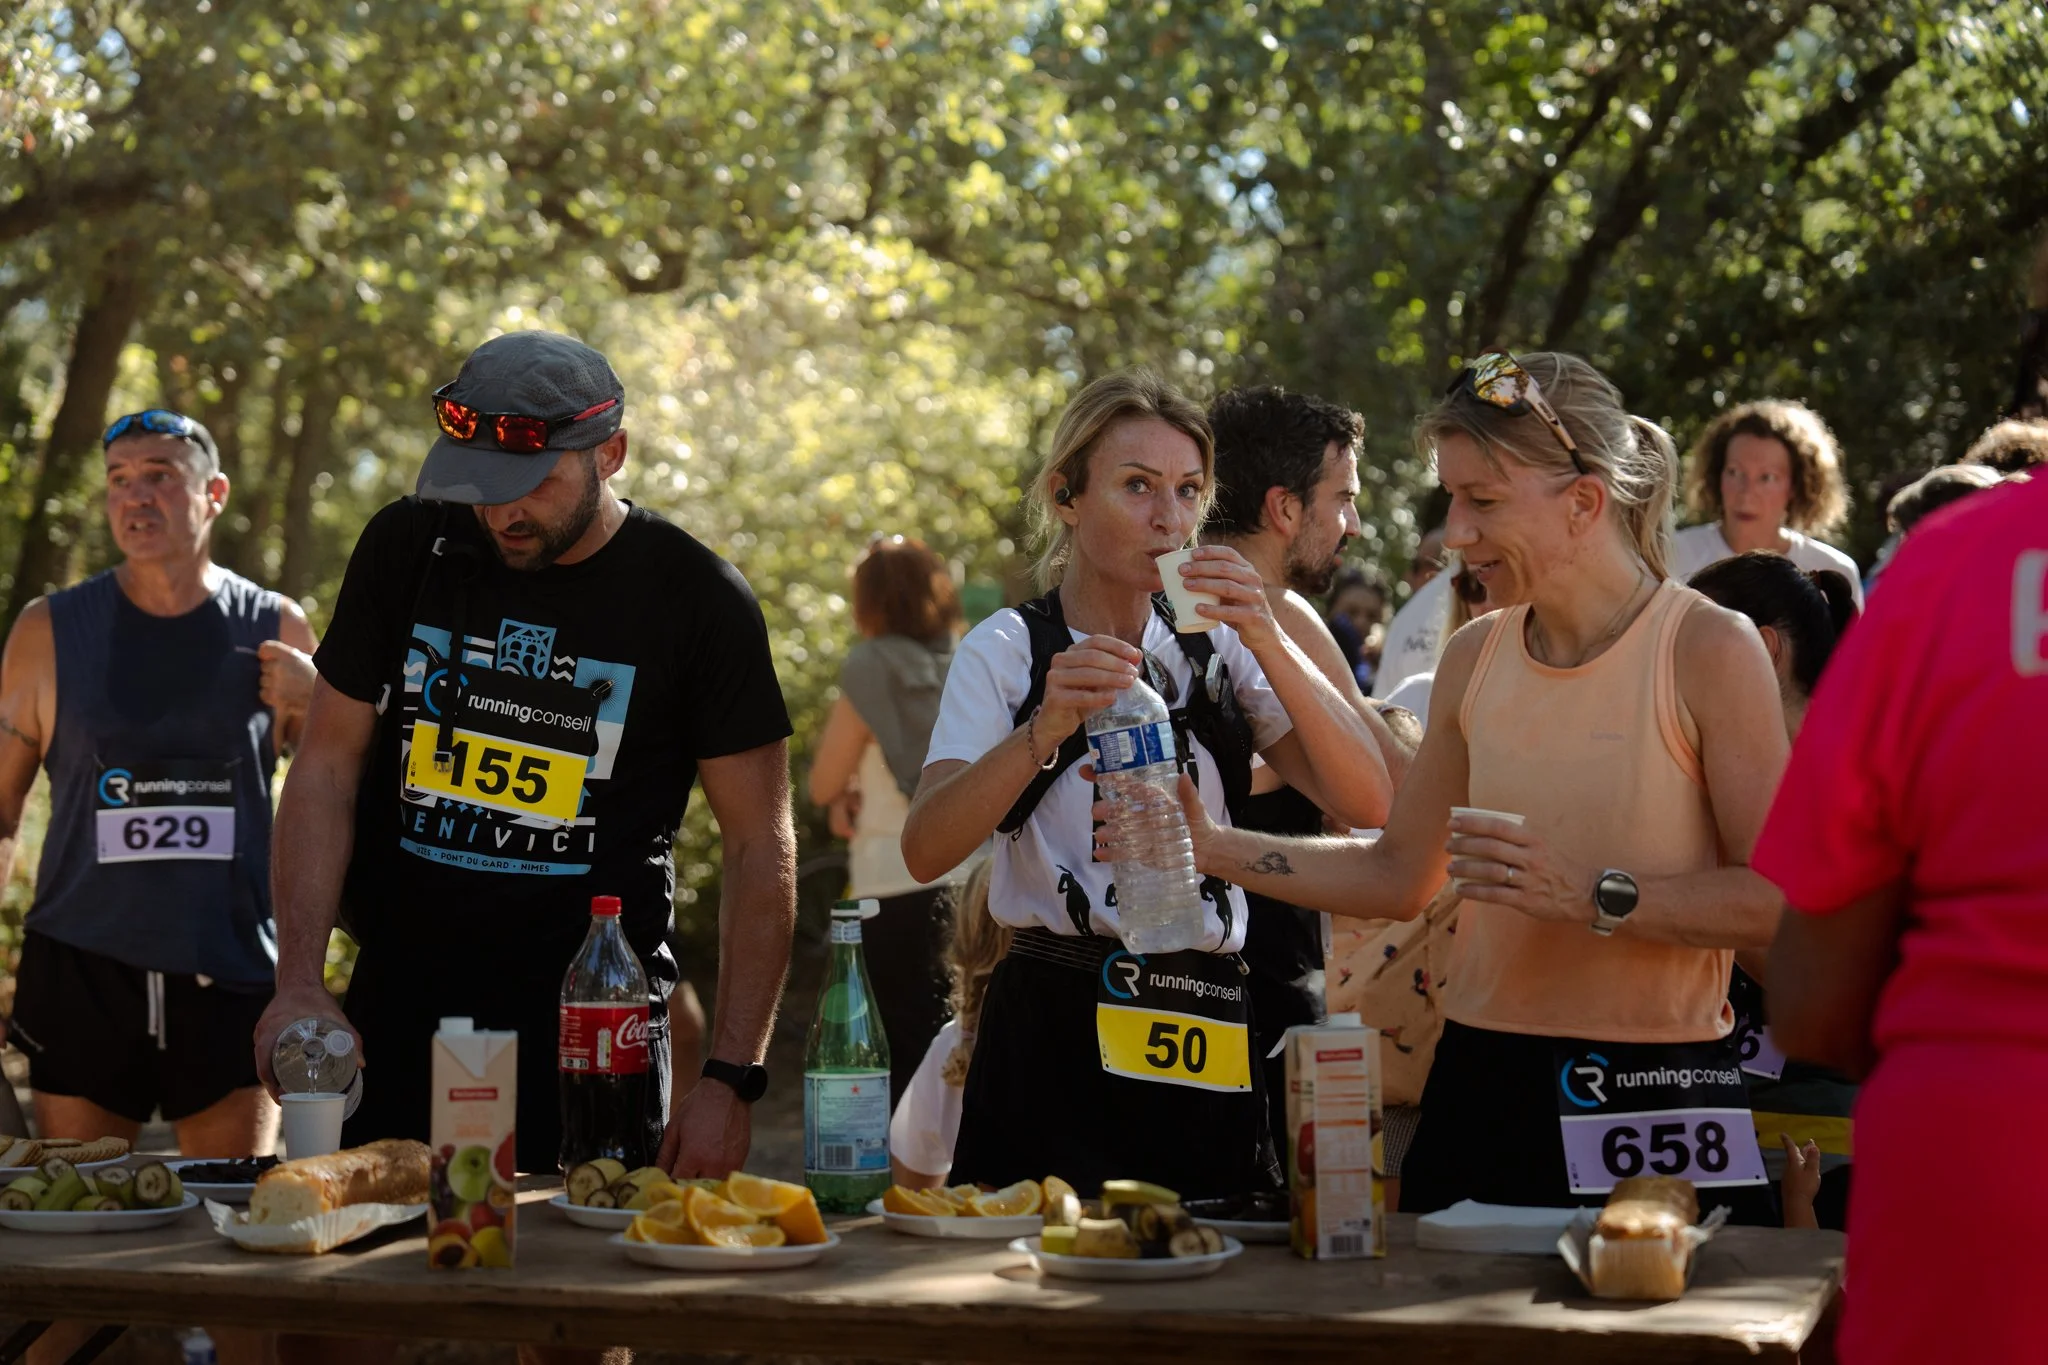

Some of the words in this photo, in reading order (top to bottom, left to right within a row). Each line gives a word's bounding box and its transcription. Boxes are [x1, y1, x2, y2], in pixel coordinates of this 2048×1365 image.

[468, 694, 592, 732] runningconseil
[450, 741, 550, 804] 155
[123, 815, 210, 850] 629
[441, 852, 465, 864] PONT
[467, 856, 478, 866] DU
[481, 858, 509, 869] GARD
[520, 863, 550, 873] NIMES
[1150, 973, 1242, 1002] runningconseil
[1144, 1021, 1207, 1074] 50
[1616, 1067, 1742, 1089] runningconseil
[1602, 1121, 1729, 1178] 658
